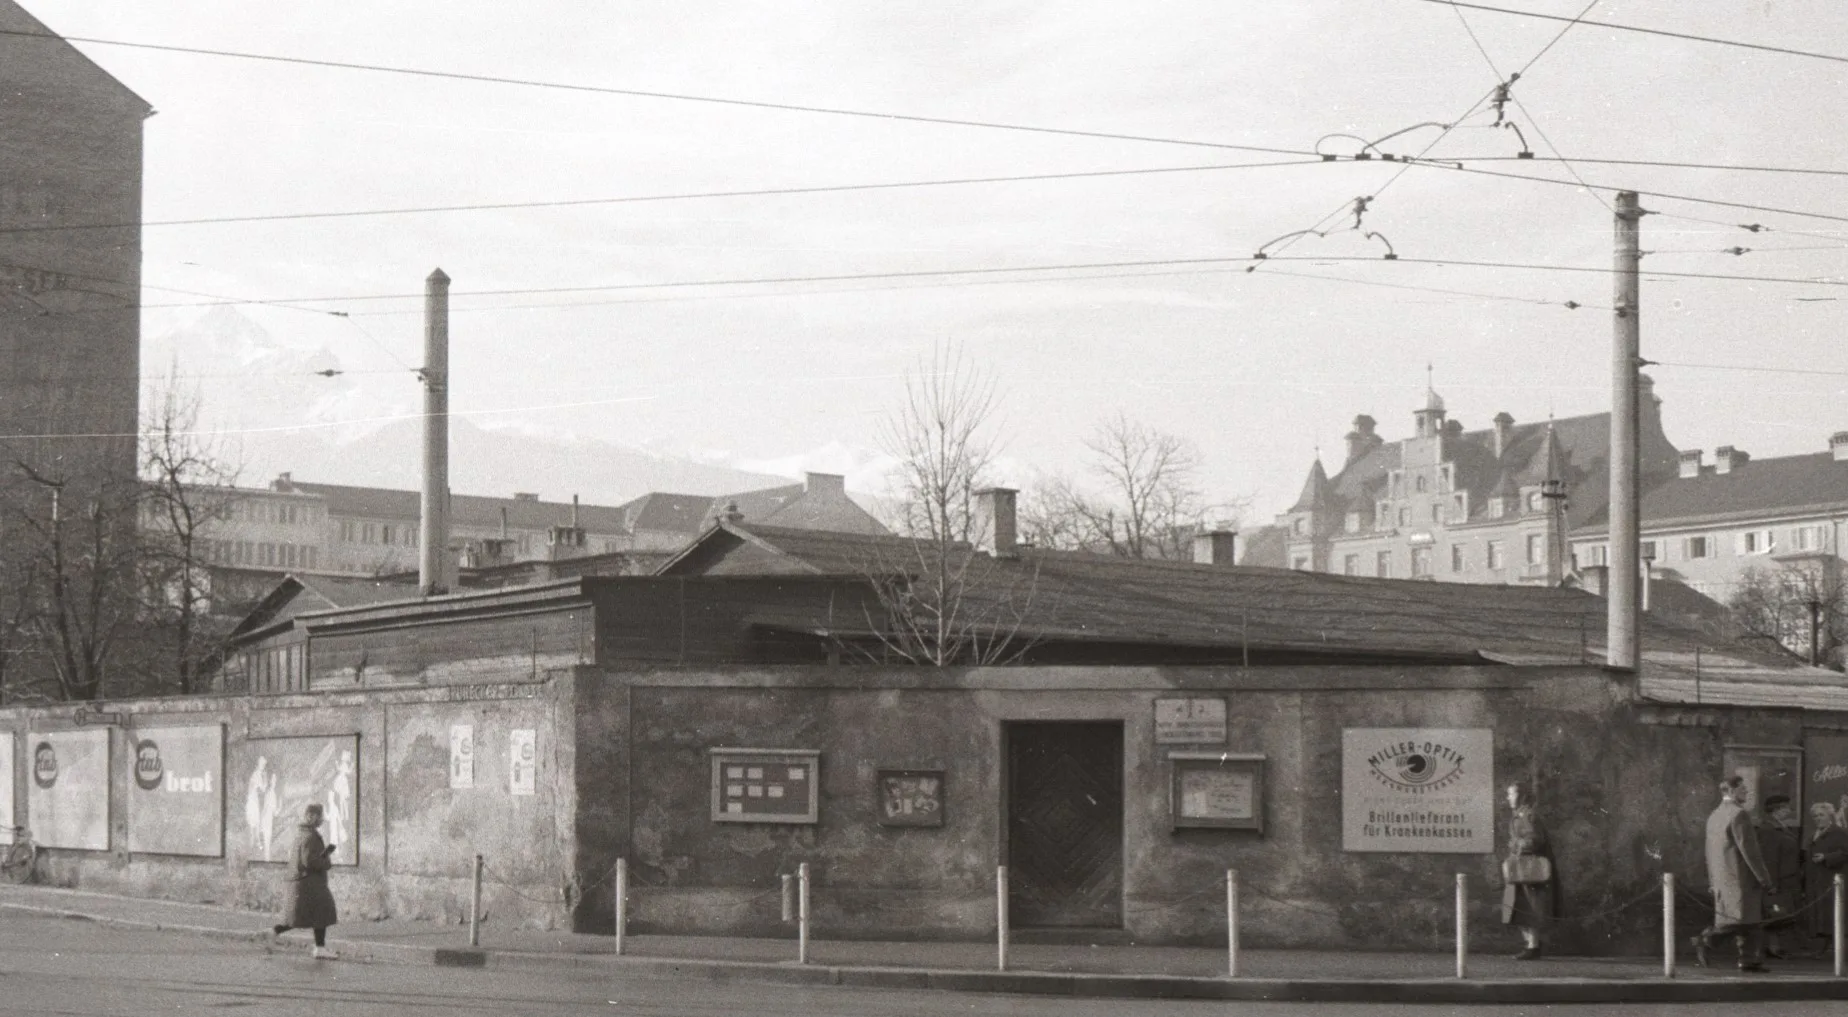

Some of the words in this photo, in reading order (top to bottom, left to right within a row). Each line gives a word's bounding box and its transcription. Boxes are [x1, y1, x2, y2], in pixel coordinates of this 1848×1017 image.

[1368, 741, 1465, 766] MILLER-OPTIK
[164, 769, 213, 793] brot
[1368, 811, 1465, 824] Brillenlieferant
[1363, 824, 1380, 837] für
[1384, 825, 1473, 838] Krankenkassen
